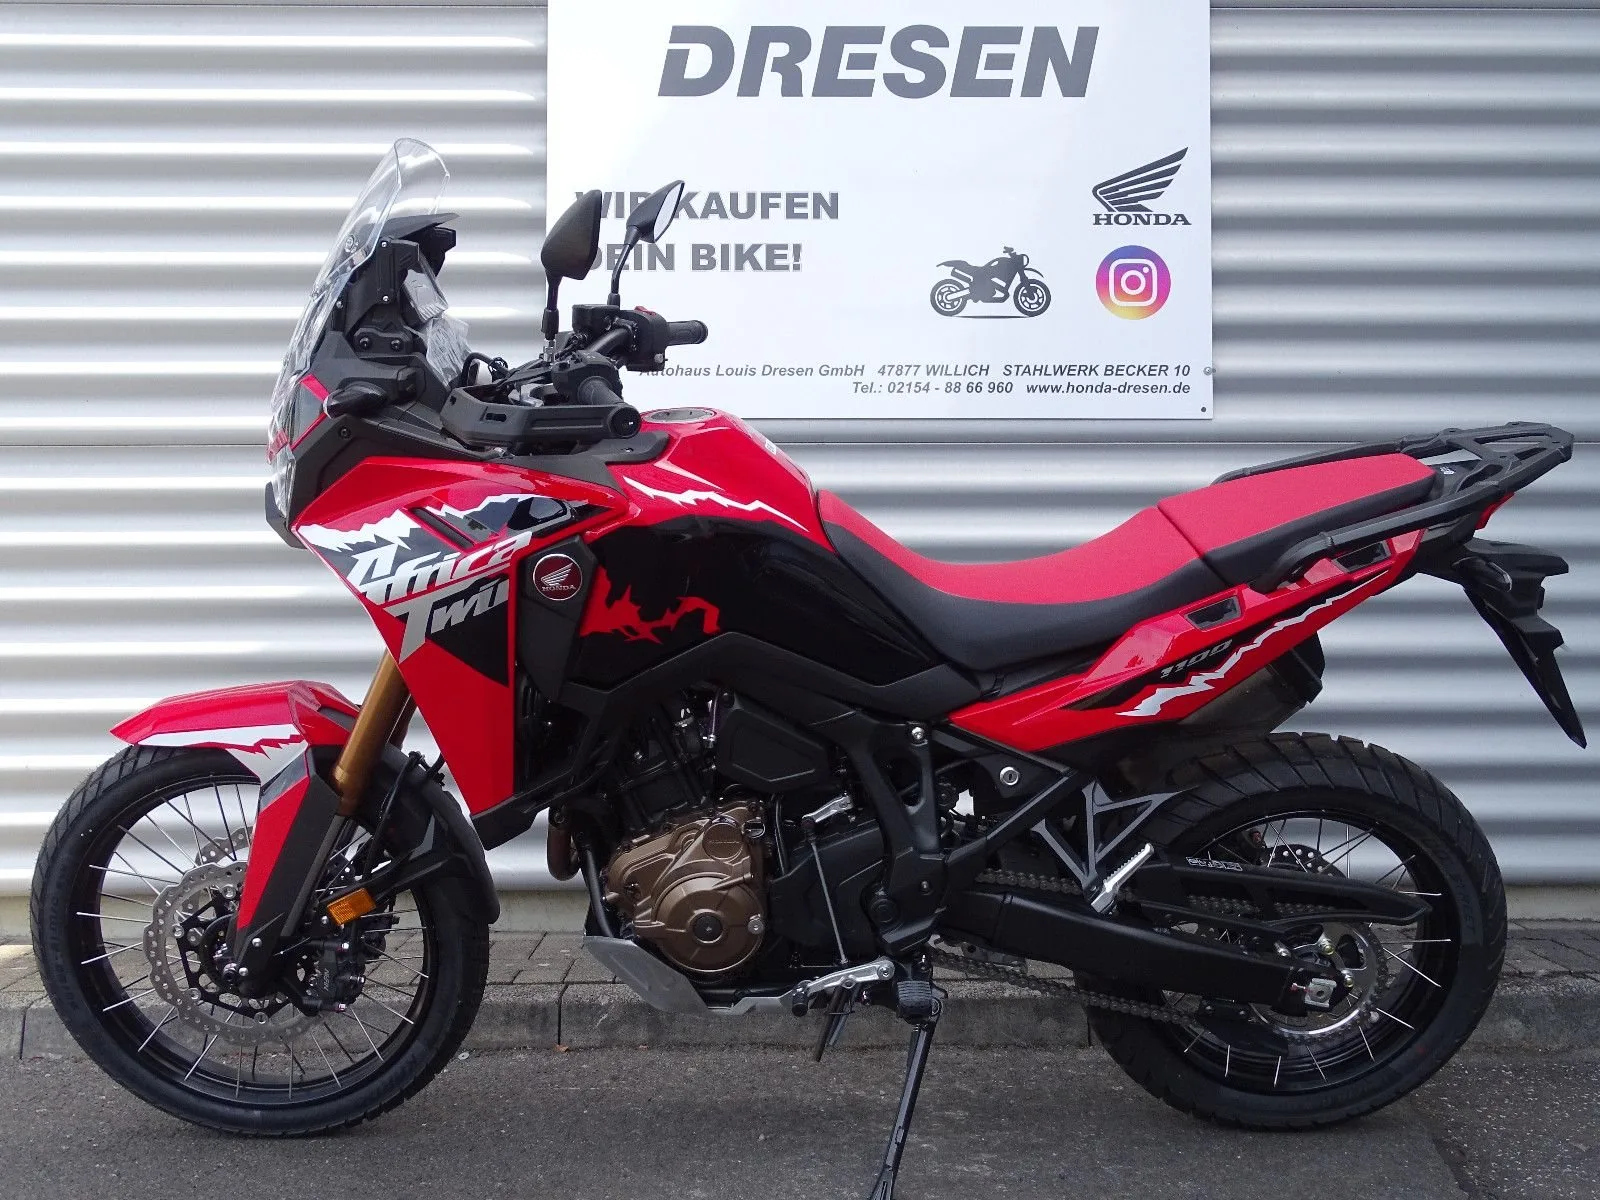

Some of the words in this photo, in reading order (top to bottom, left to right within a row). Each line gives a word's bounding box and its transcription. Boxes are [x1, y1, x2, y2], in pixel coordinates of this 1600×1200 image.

[657, 24, 1100, 99] DRESEN
[674, 191, 839, 220] KAUFEN
[1092, 213, 1192, 226] HONDA
[591, 243, 676, 271] EIN
[691, 243, 803, 272] BIKE!
[716, 364, 757, 377] Louis
[761, 364, 814, 377] Dresen
[818, 364, 865, 377] GmbH
[877, 364, 922, 377] 47877
[925, 364, 990, 377] WILLICH
[1002, 364, 1100, 377] STAHLWERK
[1103, 364, 1170, 377] BECKER
[1174, 364, 1191, 377] 10
[852, 381, 883, 394] Tel.:
[887, 381, 931, 394] 02154
[944, 381, 962, 394] 88
[966, 381, 984, 394] 66
[987, 381, 1014, 394] 960
[1026, 381, 1191, 394] www.honda-dresen.de
[346, 531, 533, 606] Africa
[541, 584, 577, 593] HONDA
[1160, 638, 1233, 679] 1100
